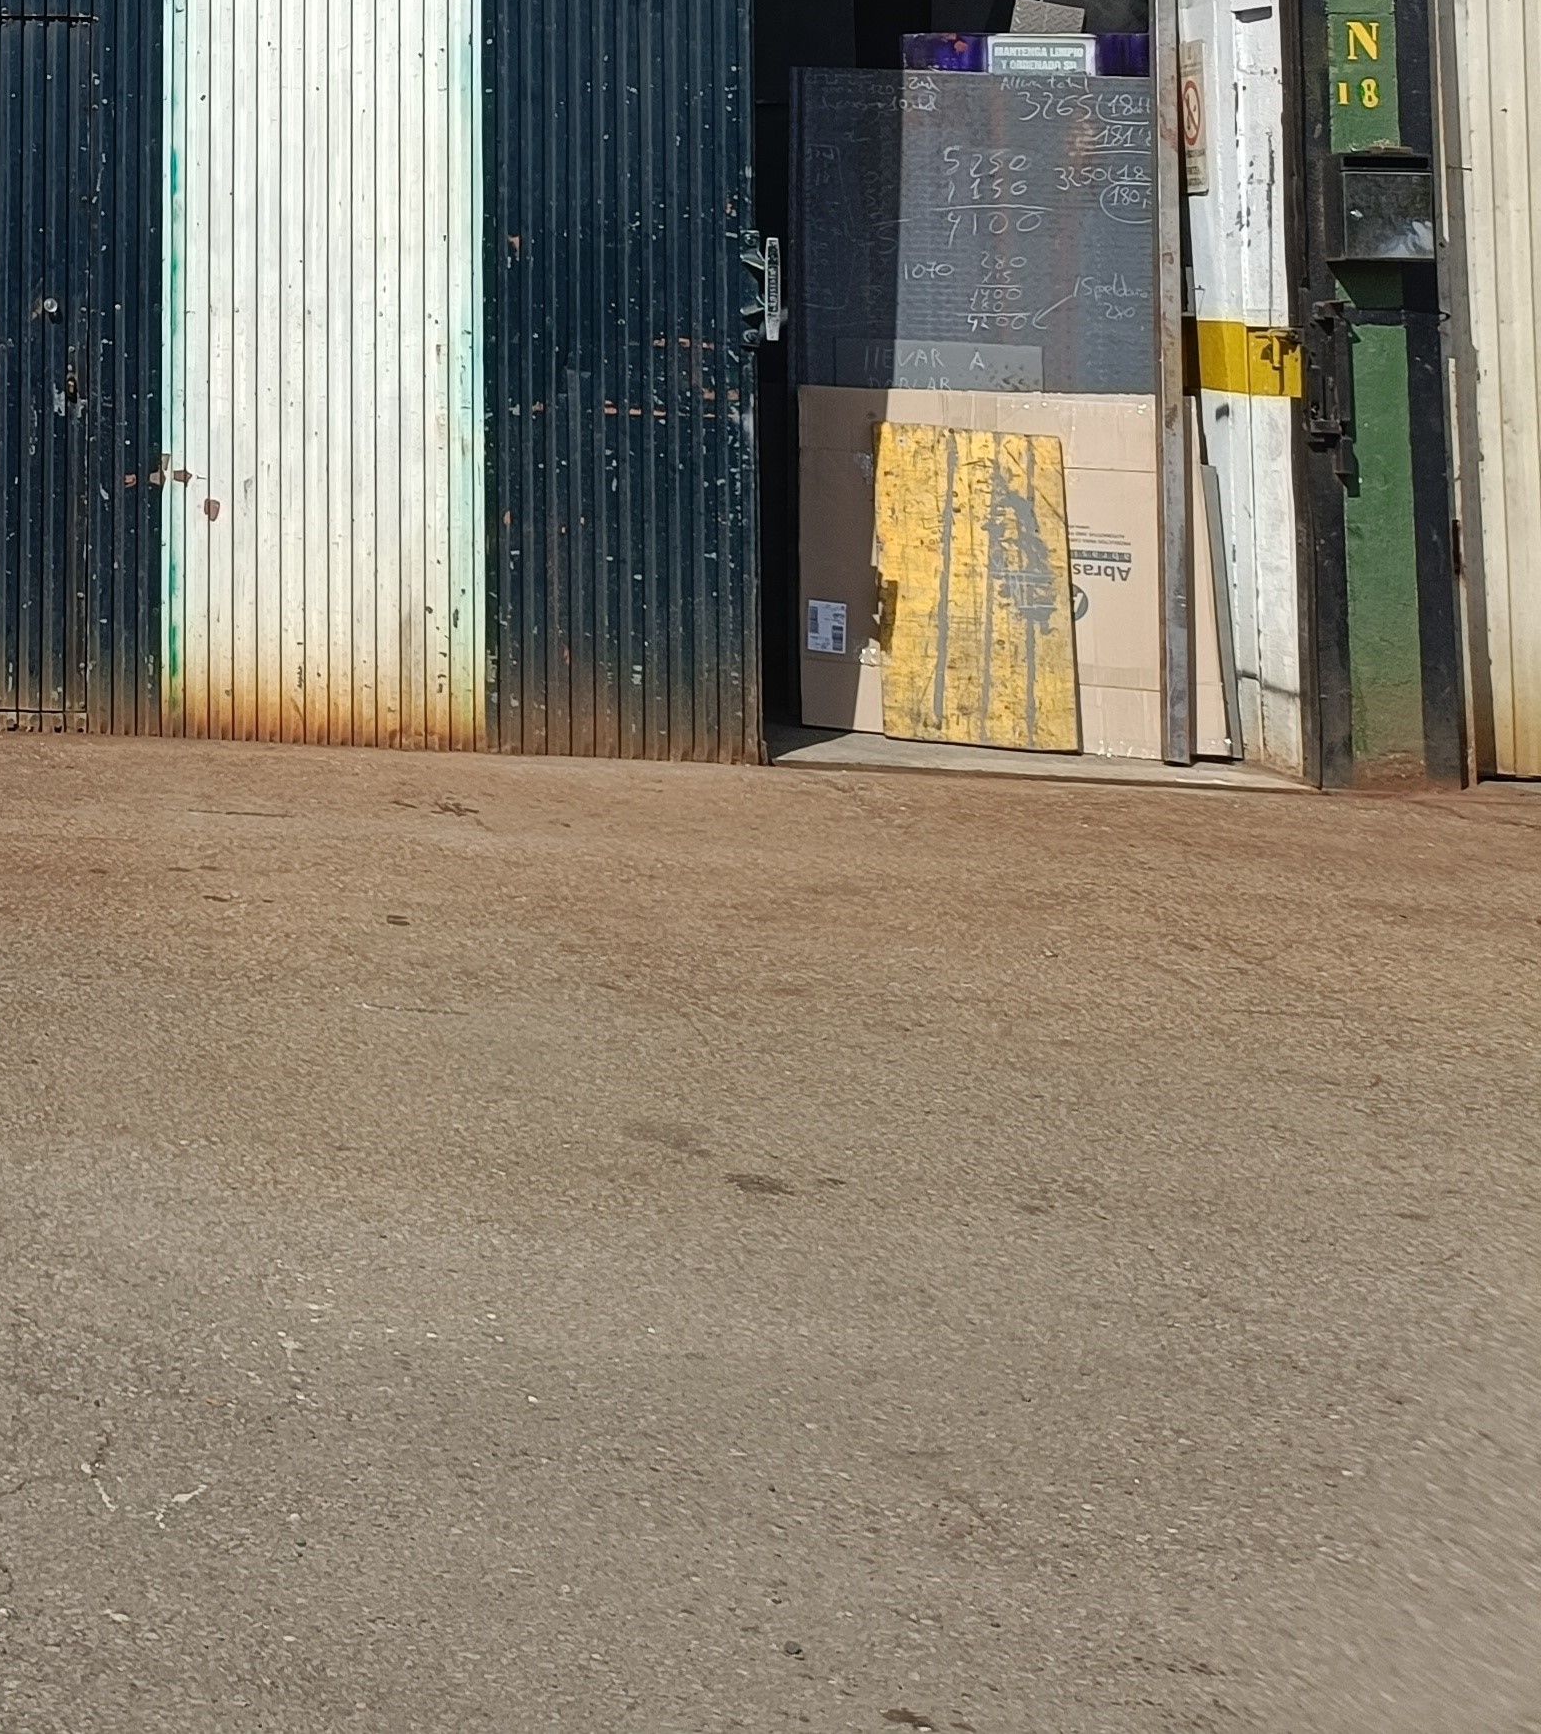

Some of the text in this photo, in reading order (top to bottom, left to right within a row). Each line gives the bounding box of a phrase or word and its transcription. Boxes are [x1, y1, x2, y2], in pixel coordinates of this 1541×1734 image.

[1345, 20, 1380, 60] N
[1337, 77, 1379, 108] 18
[968, 350, 986, 371] A
[1072, 563, 1131, 582] Abras
